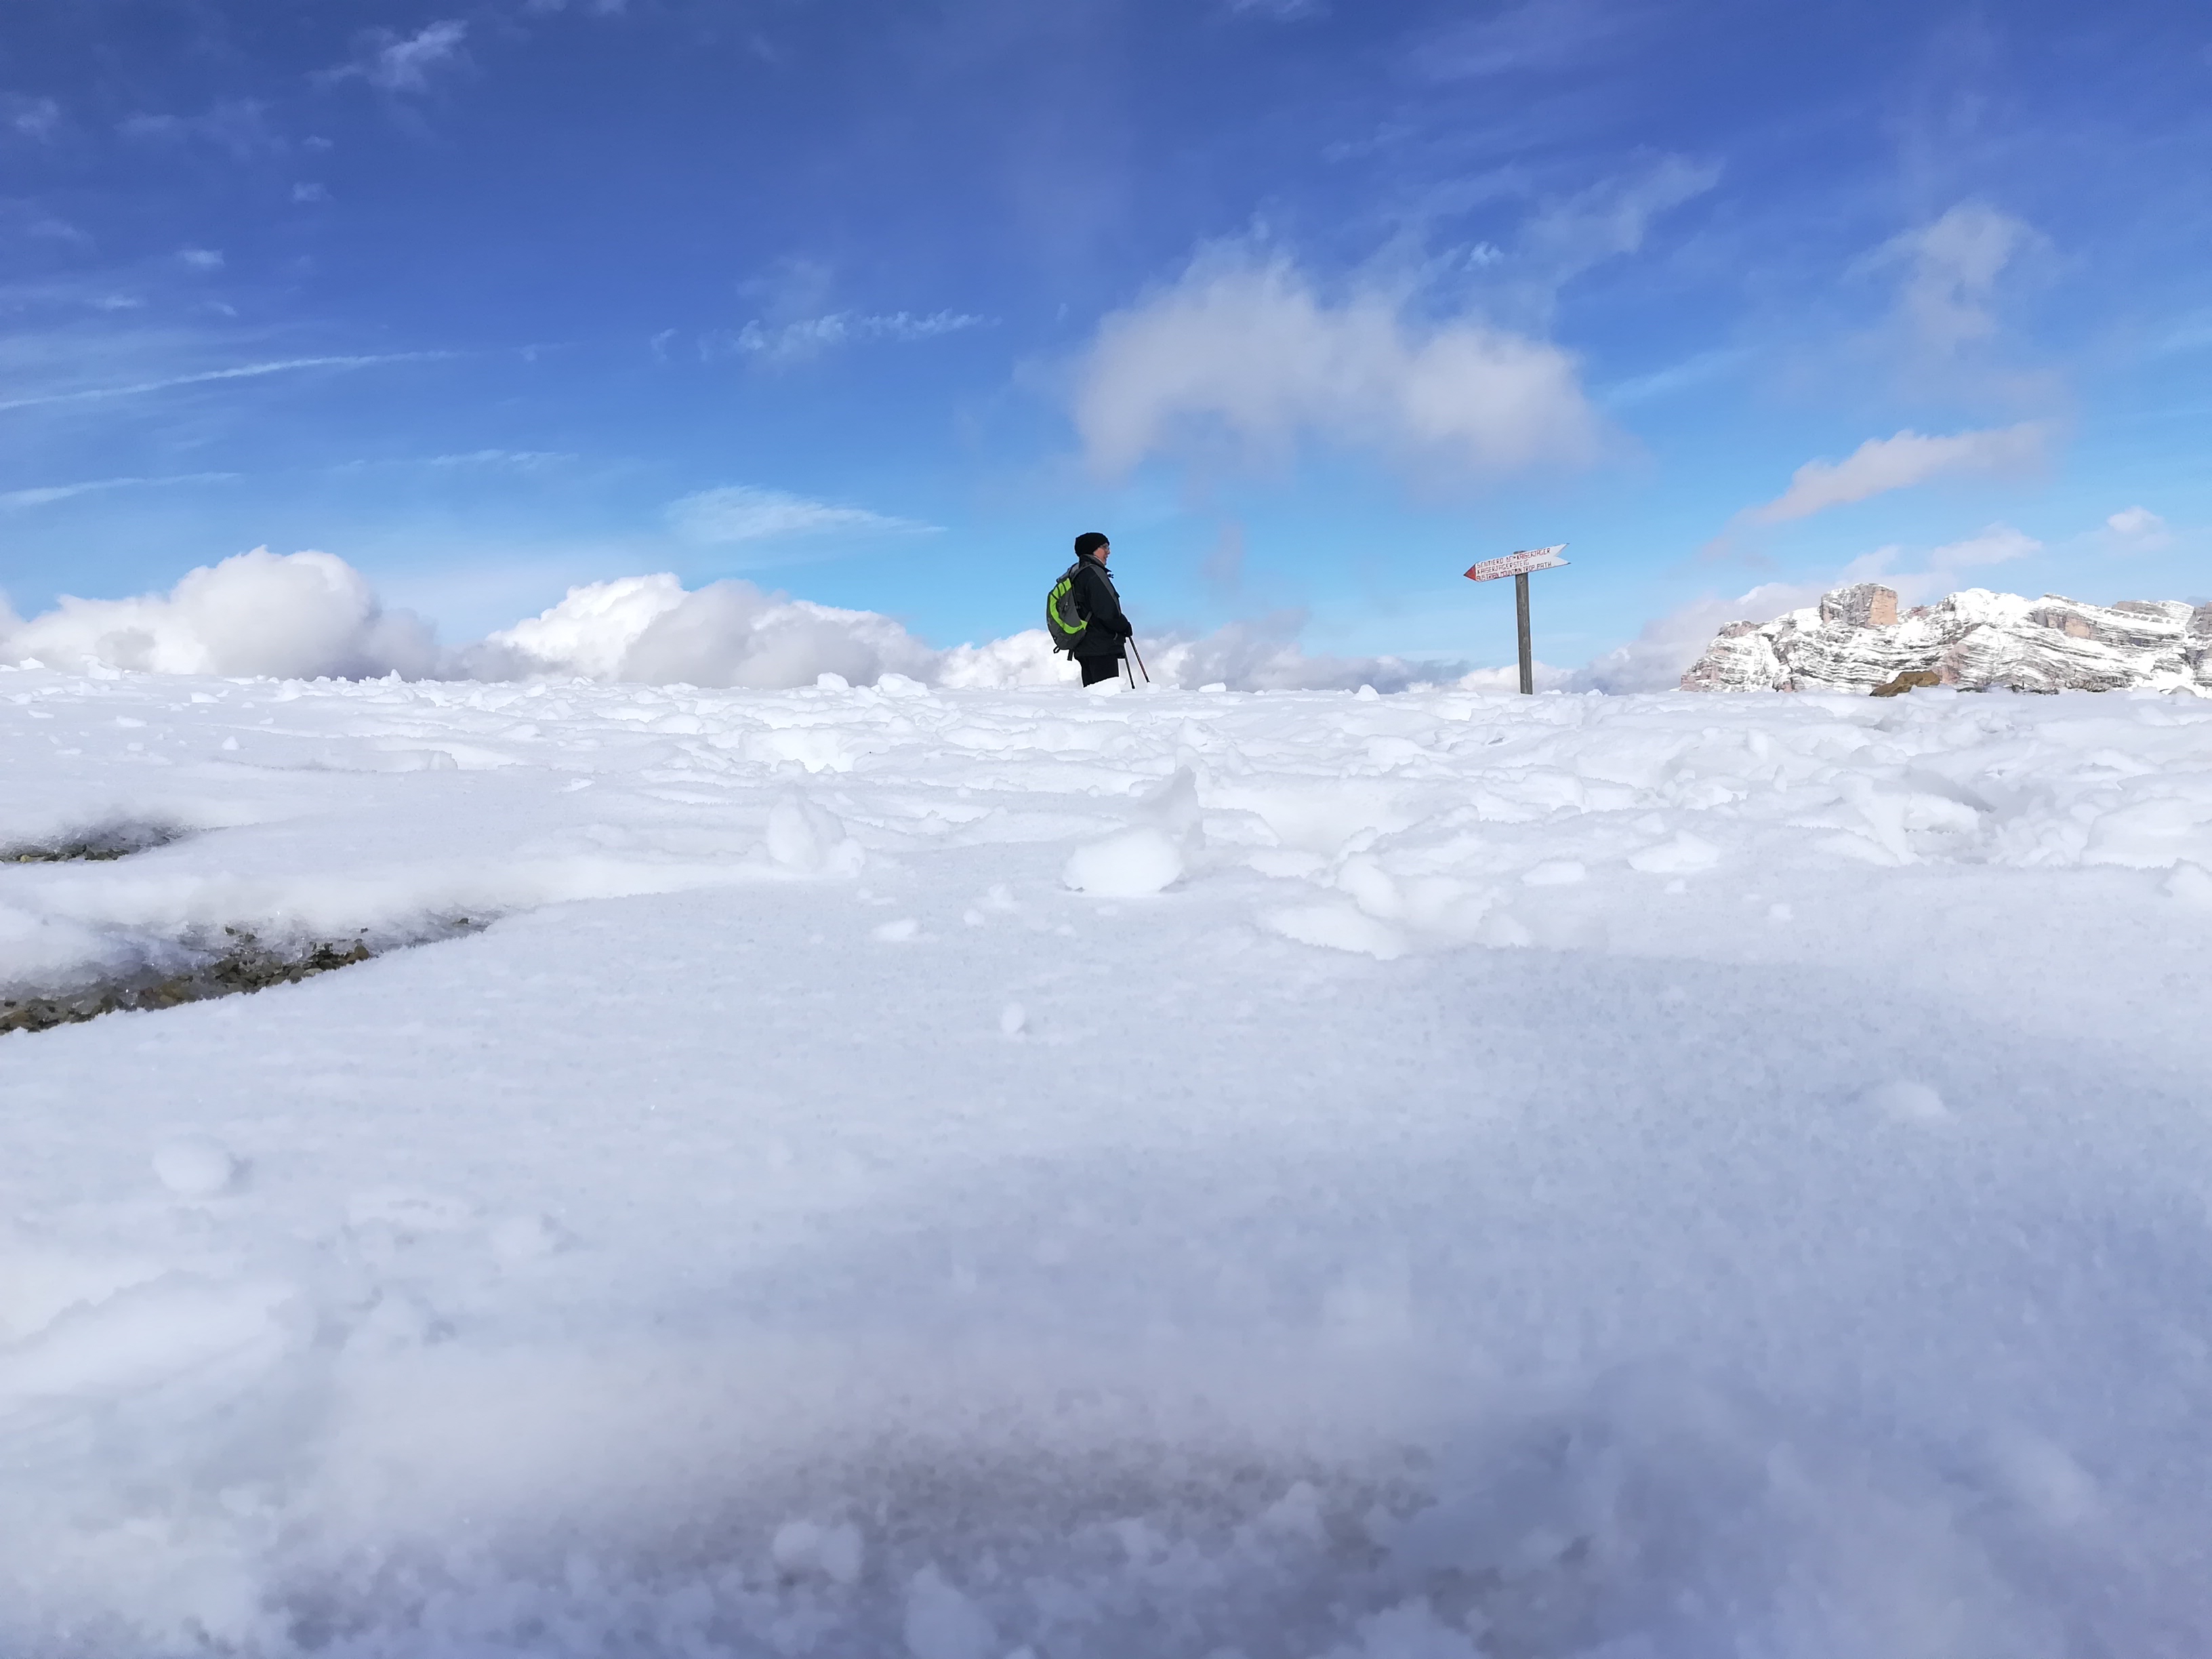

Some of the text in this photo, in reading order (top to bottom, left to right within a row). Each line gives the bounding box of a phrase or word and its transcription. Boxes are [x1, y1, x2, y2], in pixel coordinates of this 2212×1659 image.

[1477, 558, 1504, 568] SENTIERO
[1500, 568, 1522, 577] MOUNTAIN
[1537, 561, 1552, 569] PATH
